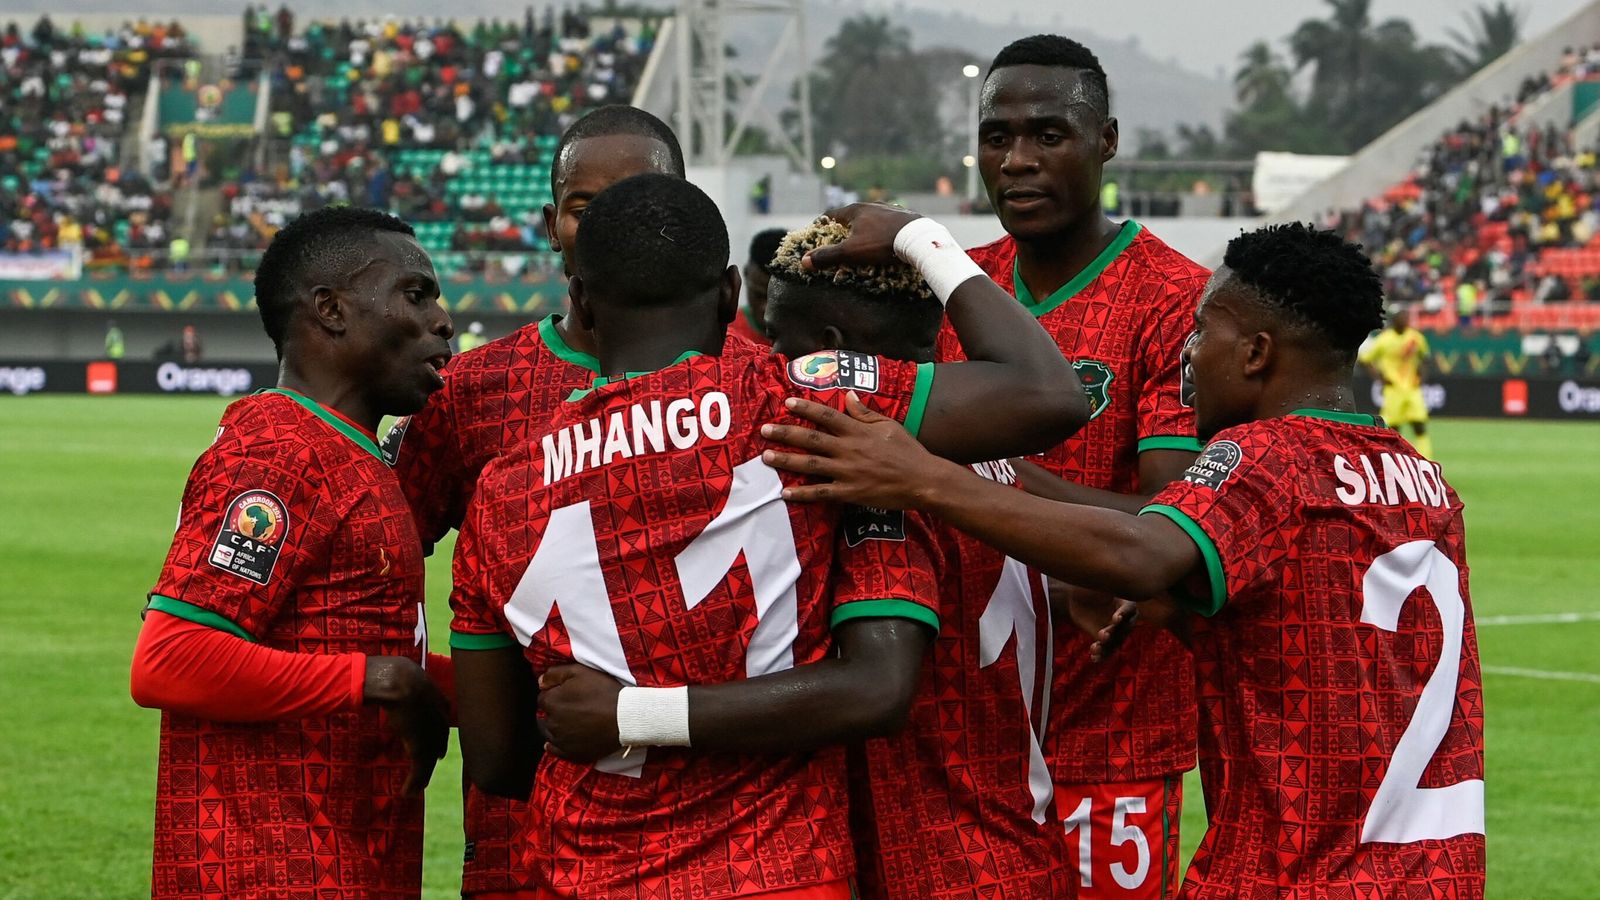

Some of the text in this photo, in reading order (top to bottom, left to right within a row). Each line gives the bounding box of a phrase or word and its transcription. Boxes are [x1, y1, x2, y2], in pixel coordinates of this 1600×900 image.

[840, 352, 850, 377] CAF
[156, 361, 252, 396] Orange
[541, 391, 731, 486] MHANGO
[238, 496, 274, 510] CAMEROON
[857, 523, 892, 536] CAF
[230, 534, 267, 553] CAF
[234, 557, 246, 565] CUP
[236, 551, 256, 563] AFRICA
[503, 455, 801, 778] 11
[1359, 539, 1486, 844] 2
[1063, 796, 1151, 890] 15
